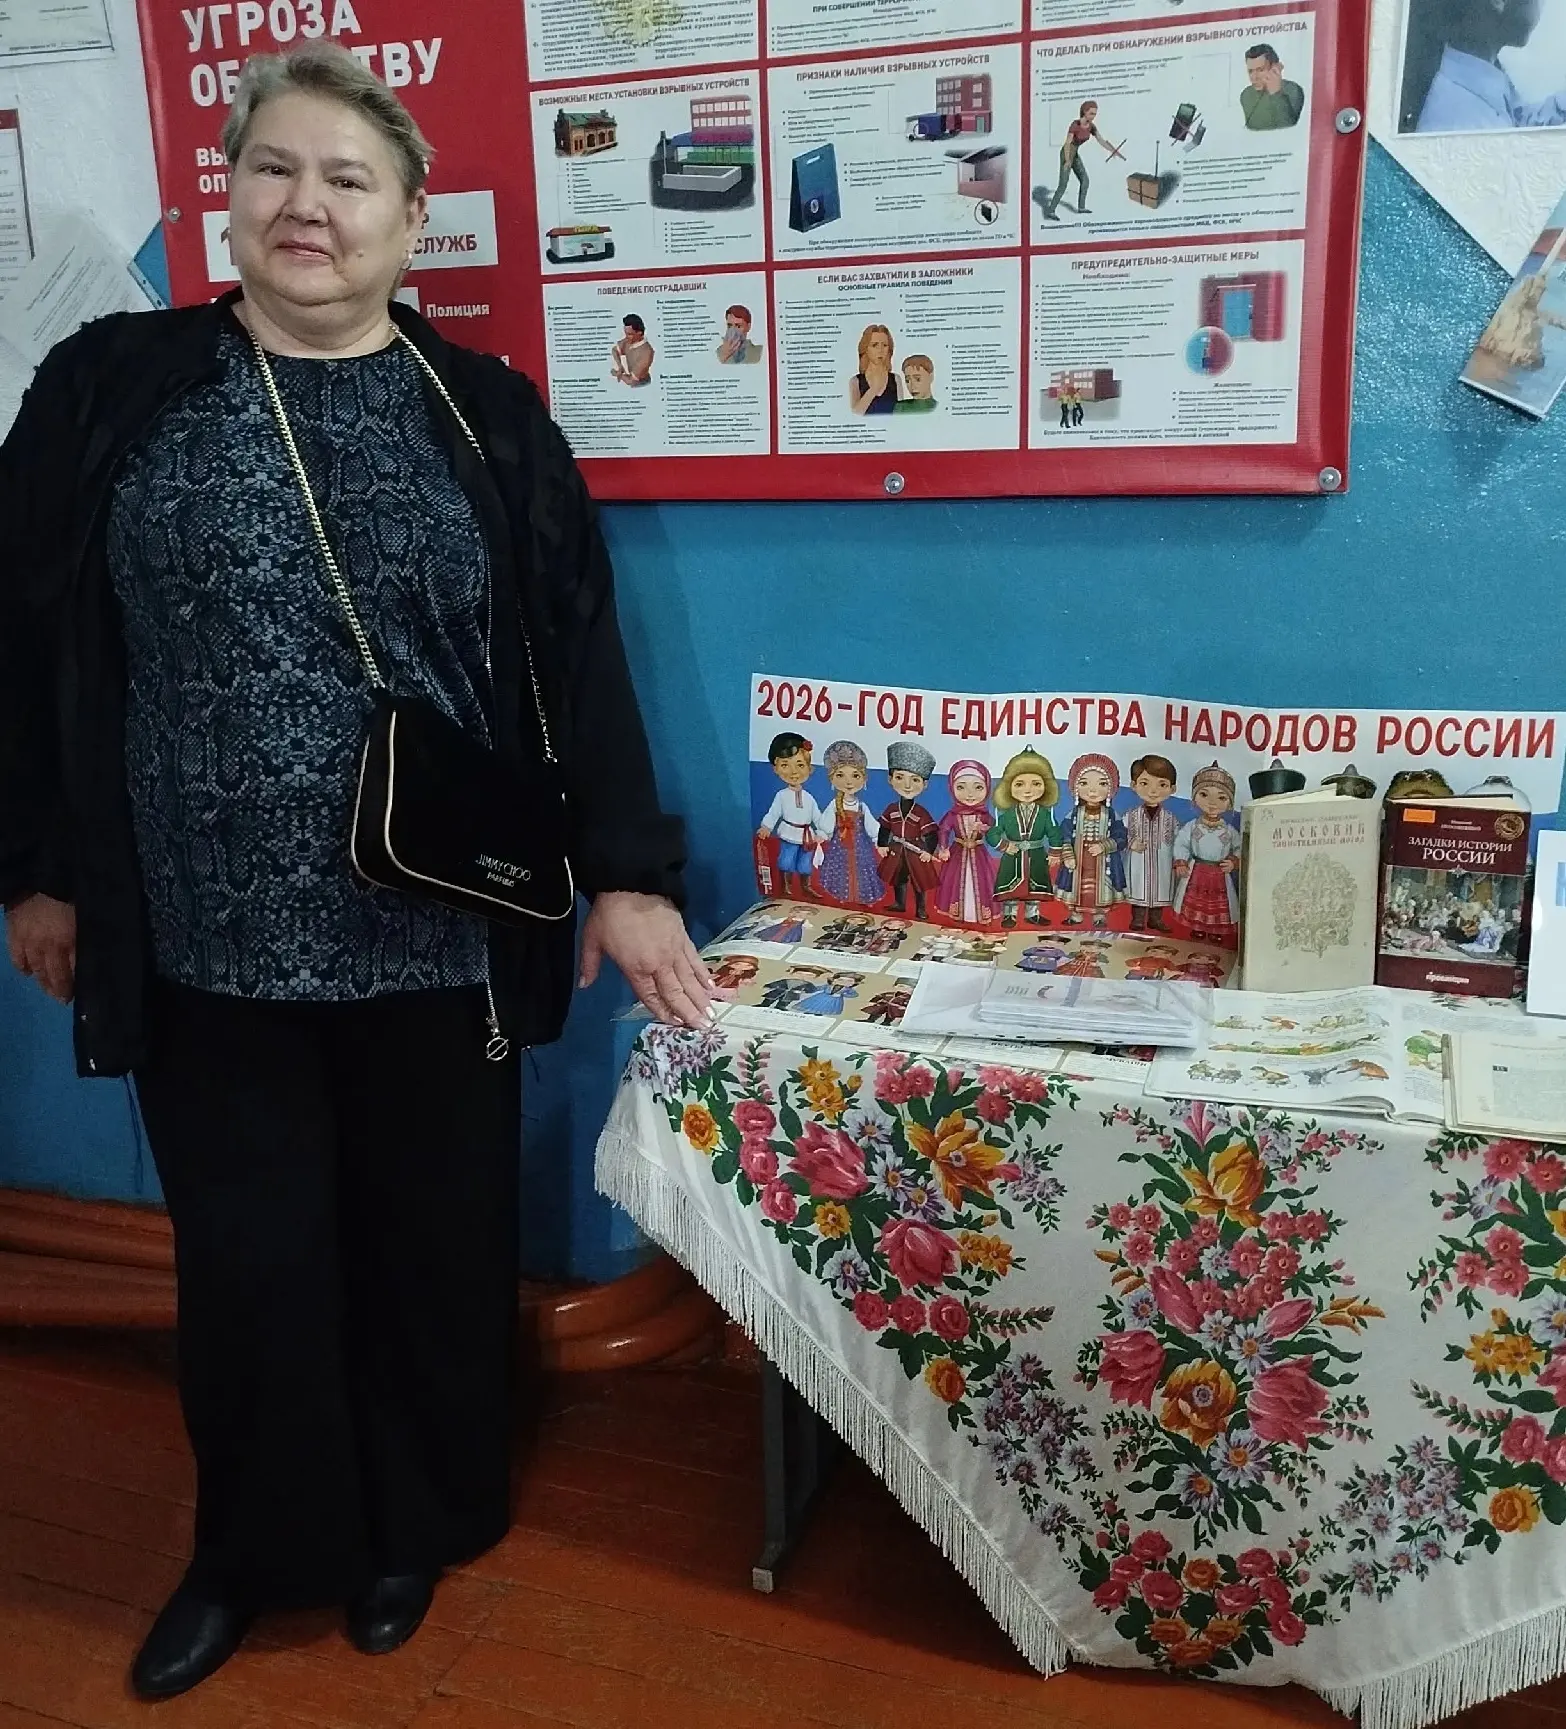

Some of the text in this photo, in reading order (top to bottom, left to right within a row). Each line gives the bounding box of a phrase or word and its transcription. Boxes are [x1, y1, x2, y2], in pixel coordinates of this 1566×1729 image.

[182, 0, 362, 52] УГРОЗА
[1037, 22, 1308, 58] ЧТО ДЕЛАТЬ ПРИ ОБНАРУЖЕНИИ ВЗРЫВНОГО УСТРОЙСТВА
[190, 38, 442, 107] ОБТВУ
[796, 54, 990, 82] ПРИЗНАКИ НАЛИЧИЯ ВЗРЫВНЫХ УСТРОЙСТВ
[538, 78, 750, 106] ВОЗМОЖНЫЕ МЕСТА УСТАНОВКИ ВЗРЫВНЫХ УСТРОЙСТВ
[1071, 251, 1260, 270] ПРЕДУПРЕДИТЕЛЬНО-ЗАЩИТНЫЕ МЕРЫ
[817, 268, 974, 284] ЕСЛИ ВАС ЗАХВАТИЛИ В ЗАЛОЖНИКИ
[838, 279, 953, 291] ОСНОВНЫЕ ПРАВИЛА ПОВЕДЕНИЯ
[597, 282, 707, 295] ПОВЕДЕНИЕ ПОСТРАДАВШИХ
[426, 303, 490, 318] Полиция
[941, 697, 1147, 741] ЕДИНСТВА
[1165, 704, 1357, 757] НАРОДОВ
[1376, 716, 1557, 759] РОССИИ
[1408, 836, 1513, 852] ЗАГАДКИ ИСТОРИИ
[475, 853, 531, 881] JIMMY CHOO
[1422, 847, 1496, 865] РОССИИ
